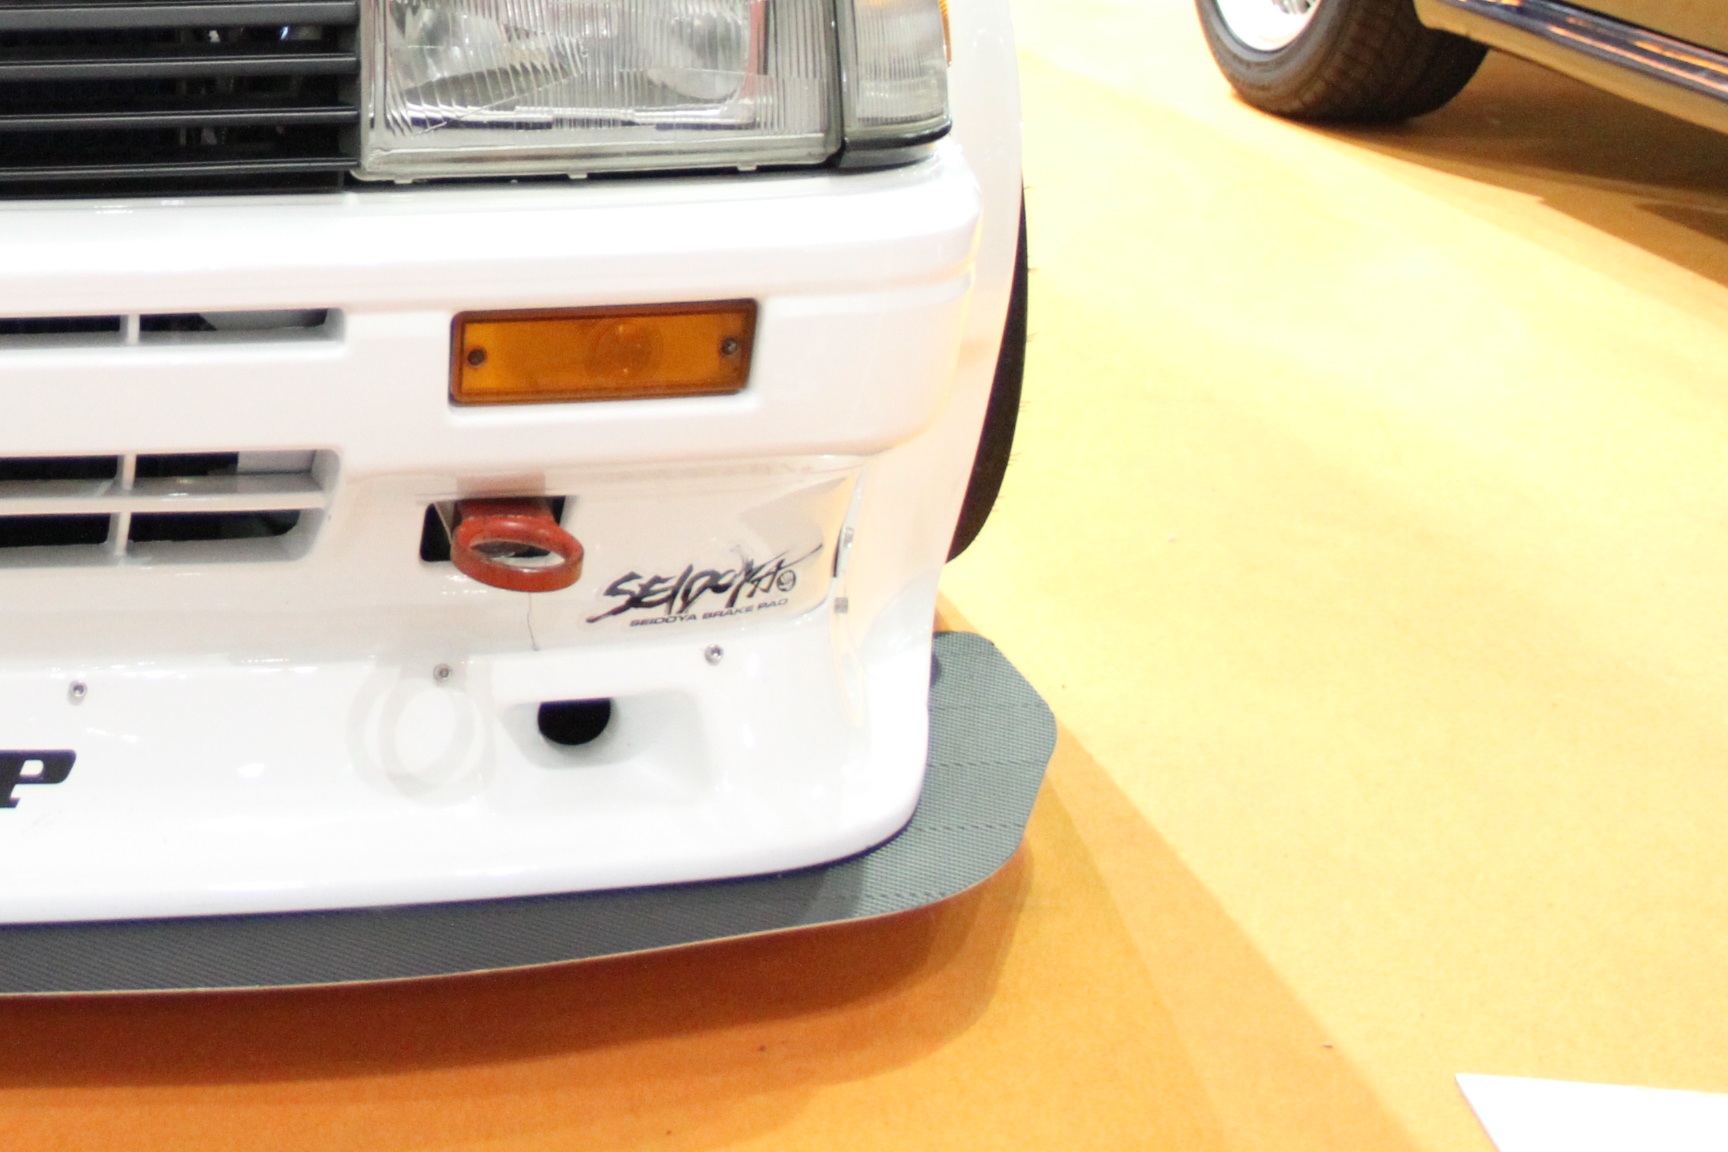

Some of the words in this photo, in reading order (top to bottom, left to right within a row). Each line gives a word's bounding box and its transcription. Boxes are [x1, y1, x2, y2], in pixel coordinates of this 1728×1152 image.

[586, 545, 823, 624] SEIDOYA
[630, 613, 697, 628] SEIDOYA
[702, 605, 753, 621] BRAKE
[757, 598, 789, 612] PAD
